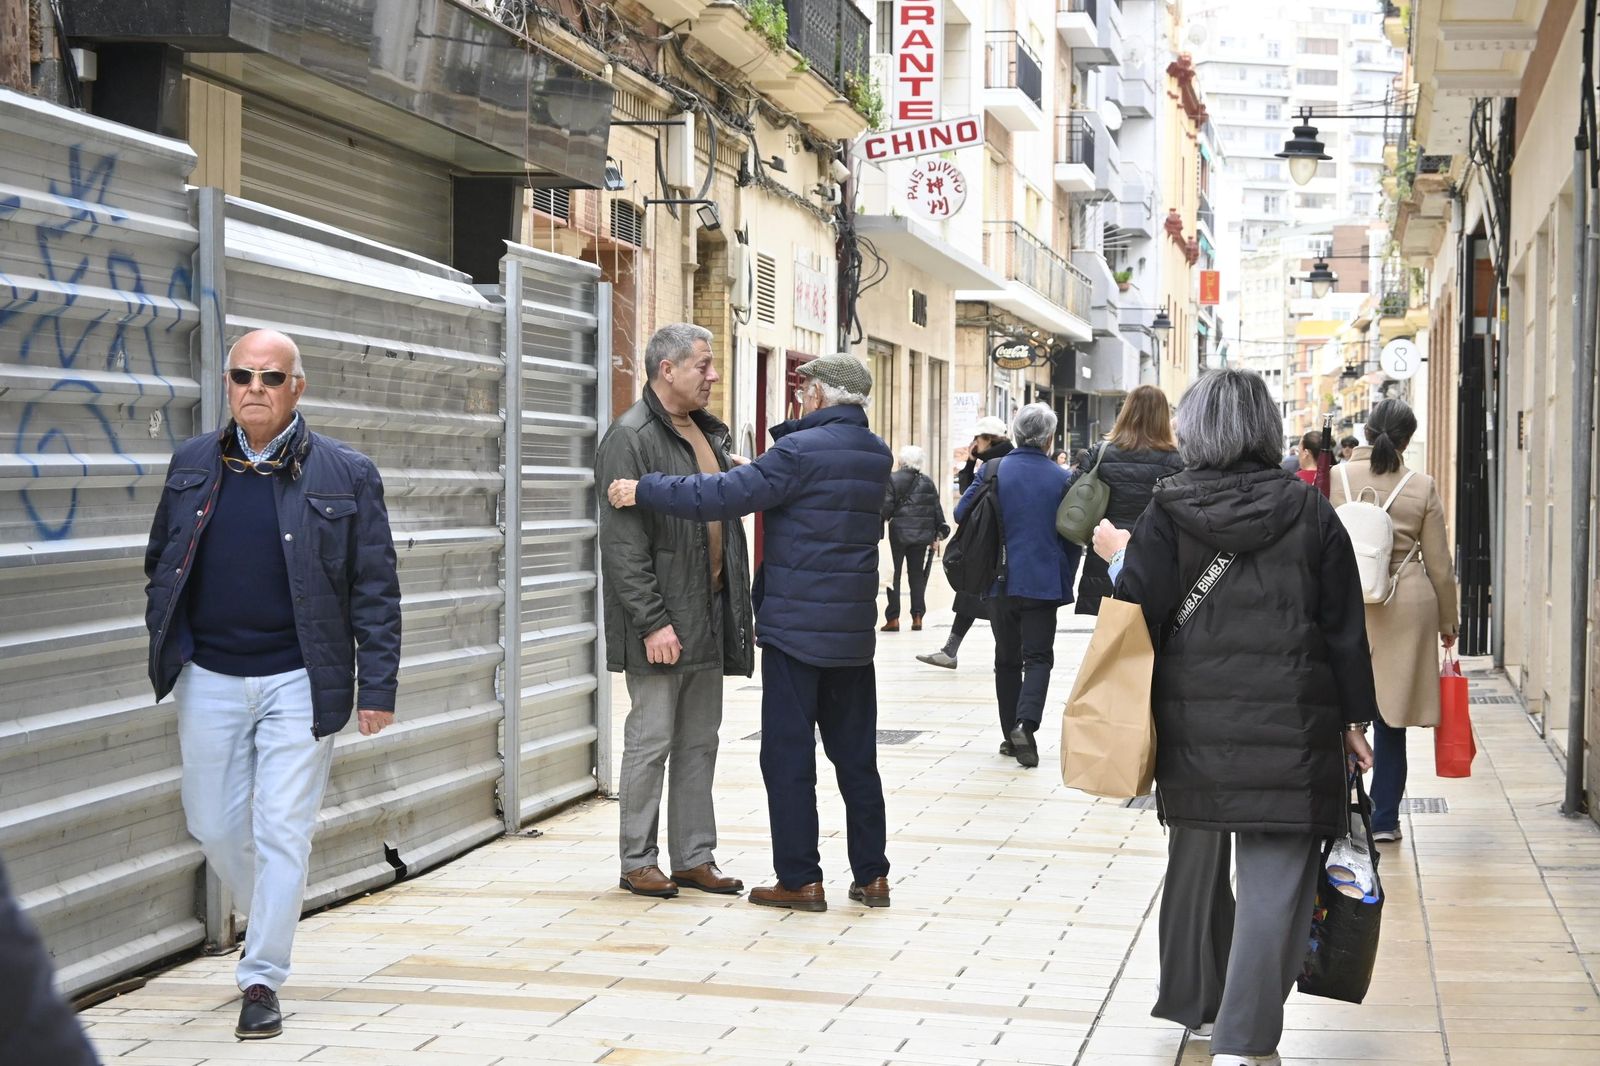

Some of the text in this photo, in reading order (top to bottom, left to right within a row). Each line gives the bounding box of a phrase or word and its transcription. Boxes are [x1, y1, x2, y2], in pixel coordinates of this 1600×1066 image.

[899, 0, 934, 120] RANTE
[865, 120, 978, 160] CHINO
[1176, 558, 1229, 625] BIMBA BIMBA
